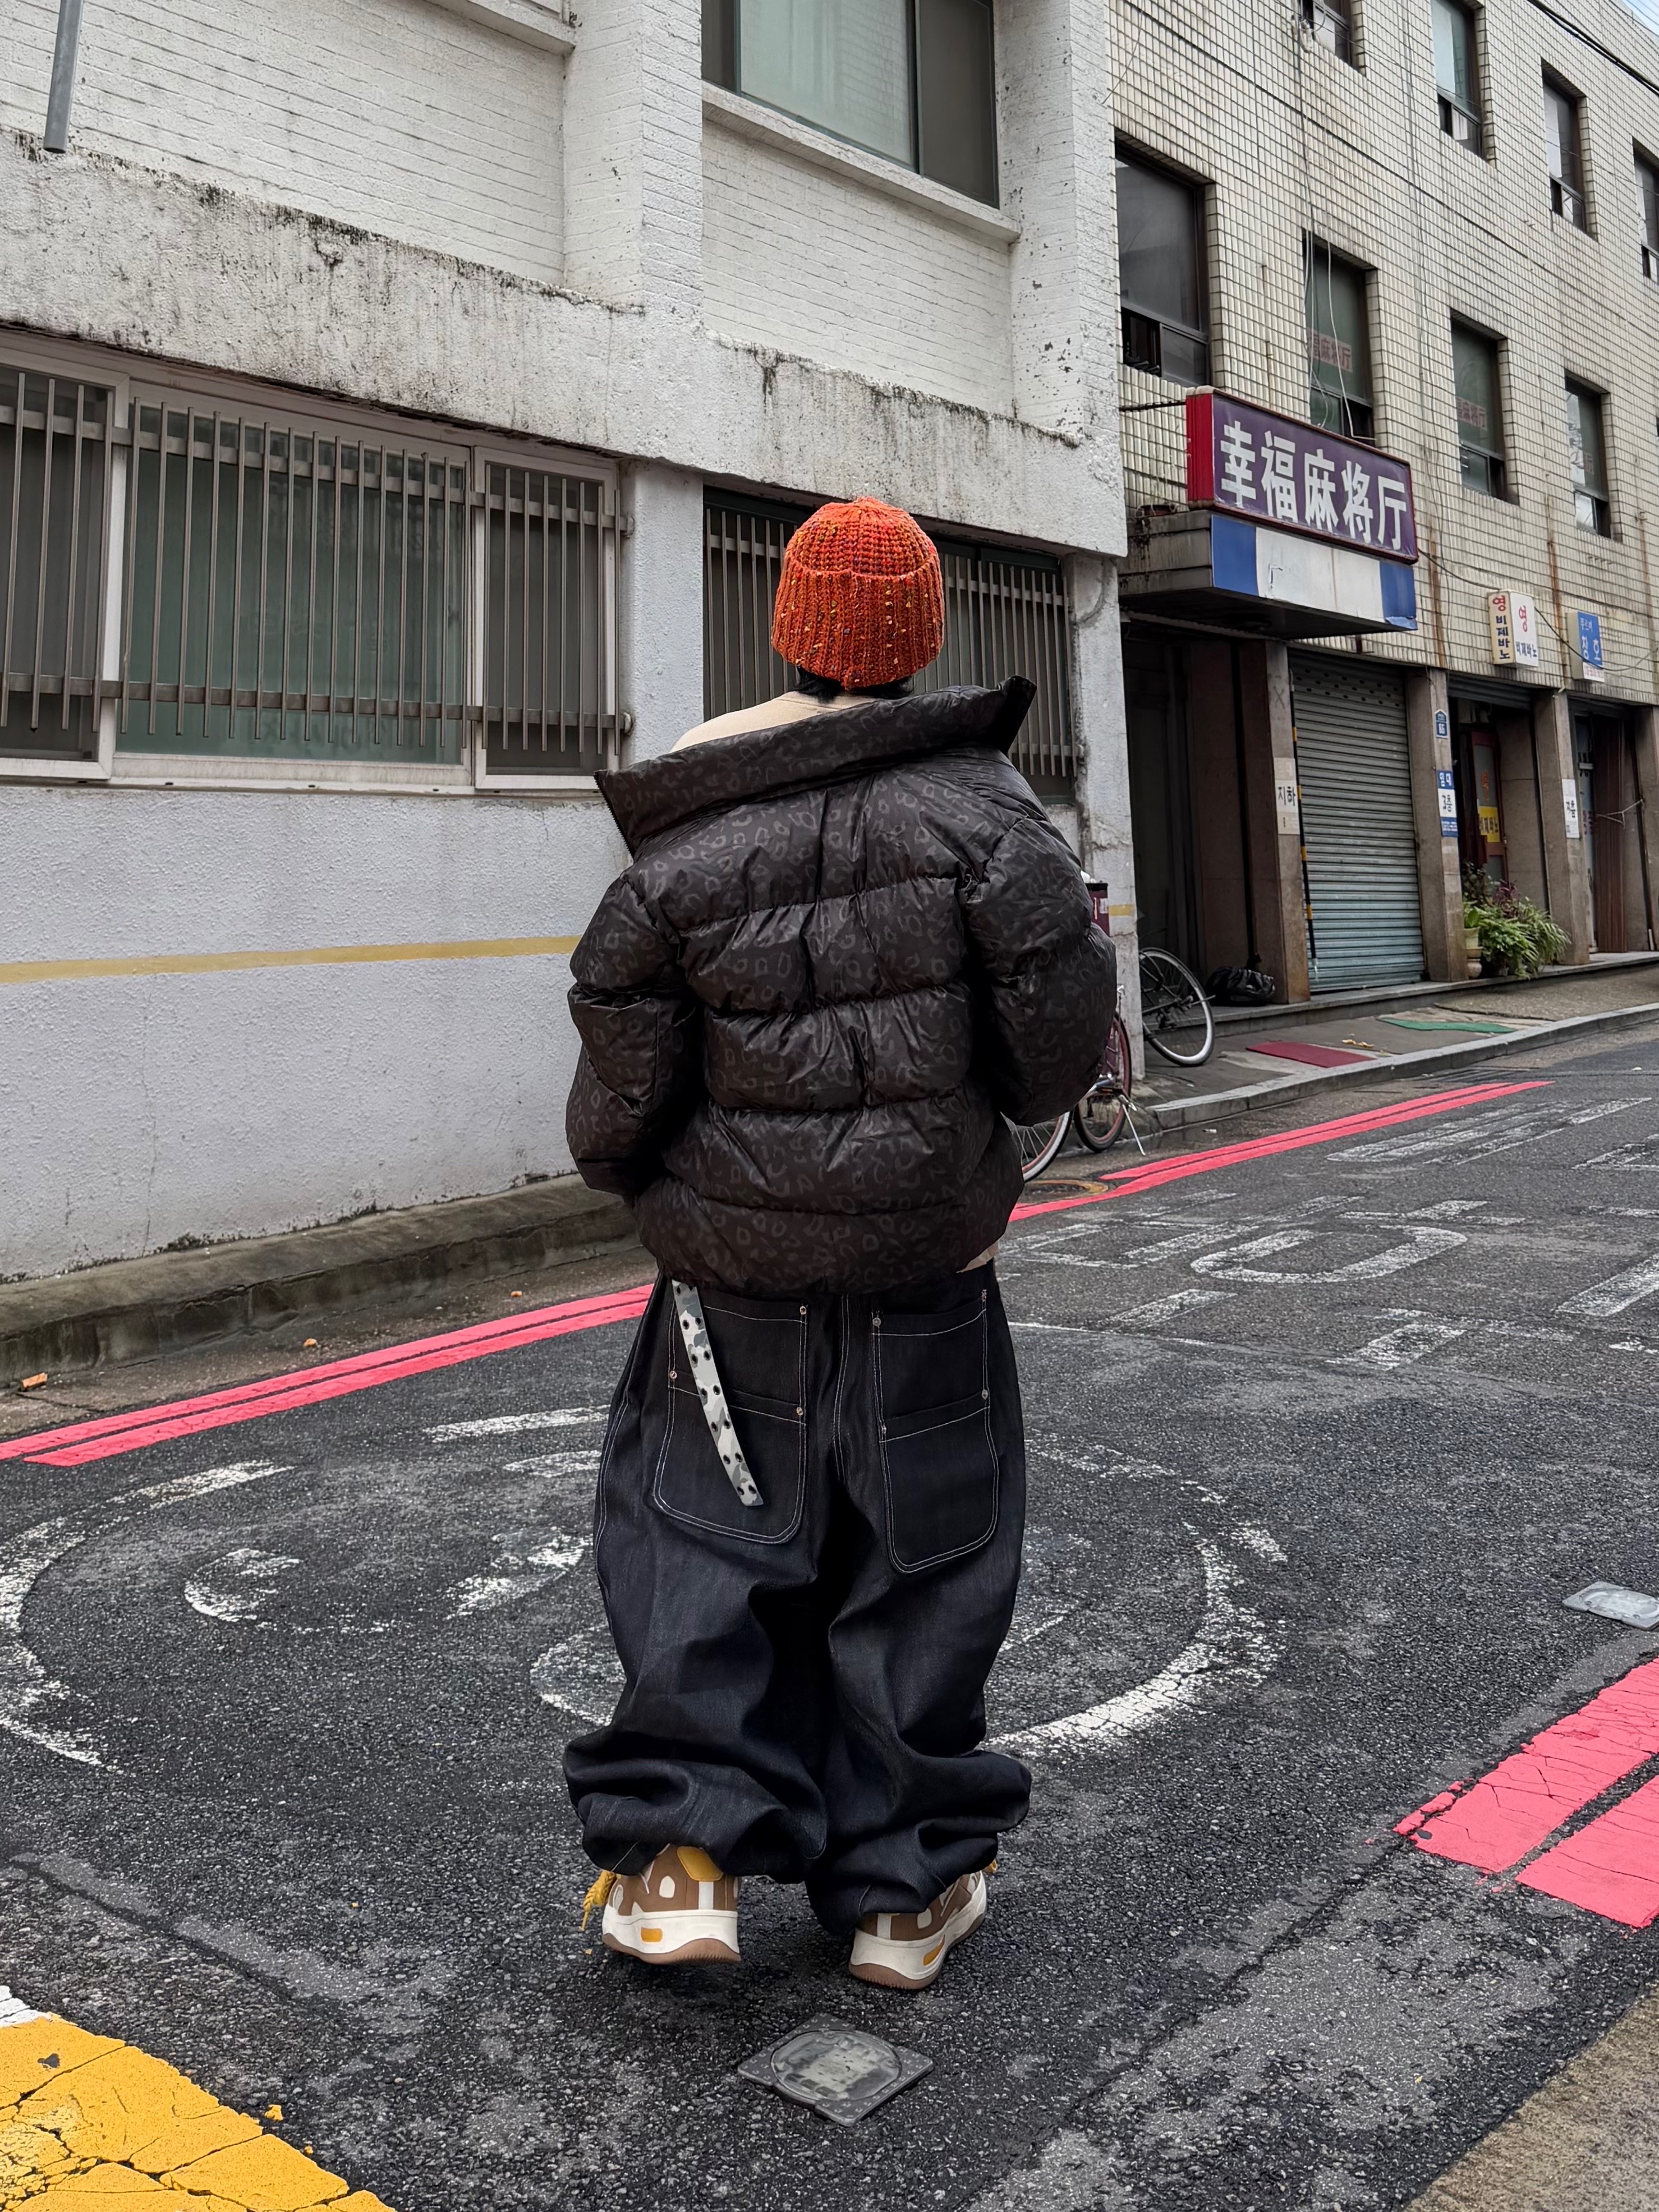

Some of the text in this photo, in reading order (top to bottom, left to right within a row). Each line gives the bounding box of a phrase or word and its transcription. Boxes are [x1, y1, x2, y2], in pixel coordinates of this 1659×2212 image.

[1220, 420, 1407, 550] 幸福麻将厅
[1492, 595, 1506, 611] 영
[1518, 605, 1528, 632] 영
[1496, 615, 1510, 660] 비제바노
[1515, 641, 1537, 657] 비제바노
[1439, 772, 1451, 787] 임대
[1277, 786, 1296, 806] 지하
[1442, 794, 1453, 812] 3층
